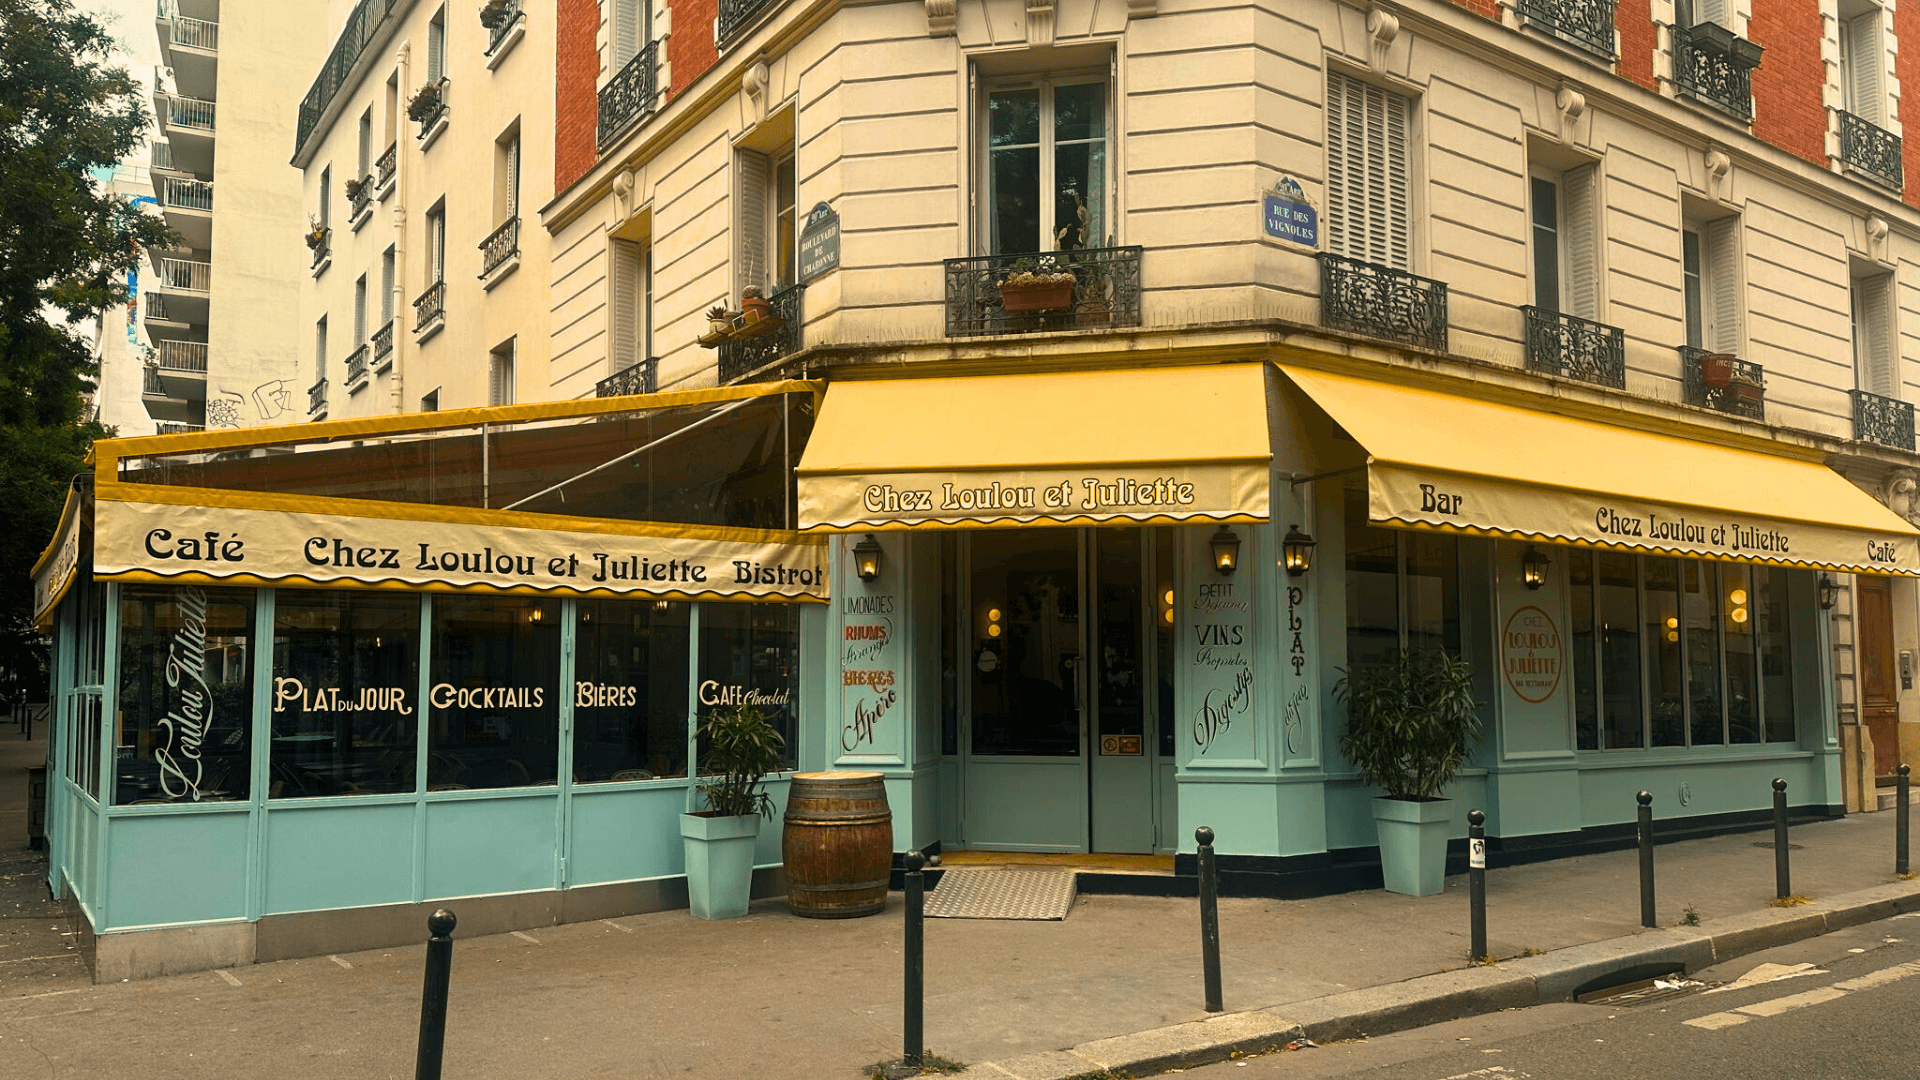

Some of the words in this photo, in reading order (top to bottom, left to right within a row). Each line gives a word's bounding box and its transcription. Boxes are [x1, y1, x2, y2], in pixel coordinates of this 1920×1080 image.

[1273, 205, 1290, 219] RUE
[1293, 210, 1309, 224] DES
[801, 226, 837, 253] BOULEVARD
[1268, 218, 1314, 240] VIGNOLES
[803, 251, 835, 275] CHARONNE
[863, 484, 933, 513] Chez
[941, 481, 1035, 511] Loulou
[1043, 480, 1073, 507] et
[1082, 477, 1195, 510] Juliette
[1419, 483, 1462, 515] Bar
[1596, 507, 1642, 537] Chez
[1649, 514, 1705, 544] Loulou
[1711, 524, 1726, 546] et
[1732, 523, 1789, 552] Juliette
[145, 528, 245, 562] Café
[1867, 539, 1896, 563] Café
[304, 536, 401, 569] Chez
[415, 543, 535, 576] Loulou
[548, 552, 579, 578] et
[592, 552, 707, 583] Juliette
[732, 560, 823, 586] Bistrot
[1199, 583, 1234, 597] PETIT
[842, 595, 894, 614] LIMONADES
[845, 625, 887, 640] RHUMS
[1194, 624, 1244, 646] VINS
[1287, 586, 1304, 676] PLAT
[1508, 632, 1556, 649] LOULOU
[165, 585, 214, 739] Juliette
[1508, 658, 1557, 675] JULIETTE
[430, 683, 544, 709] COCKTAILS
[575, 681, 637, 708] BIÈRES
[743, 686, 791, 706] Chocolat
[1193, 667, 1253, 755] Digestifs
[155, 689, 204, 802] Loulou
